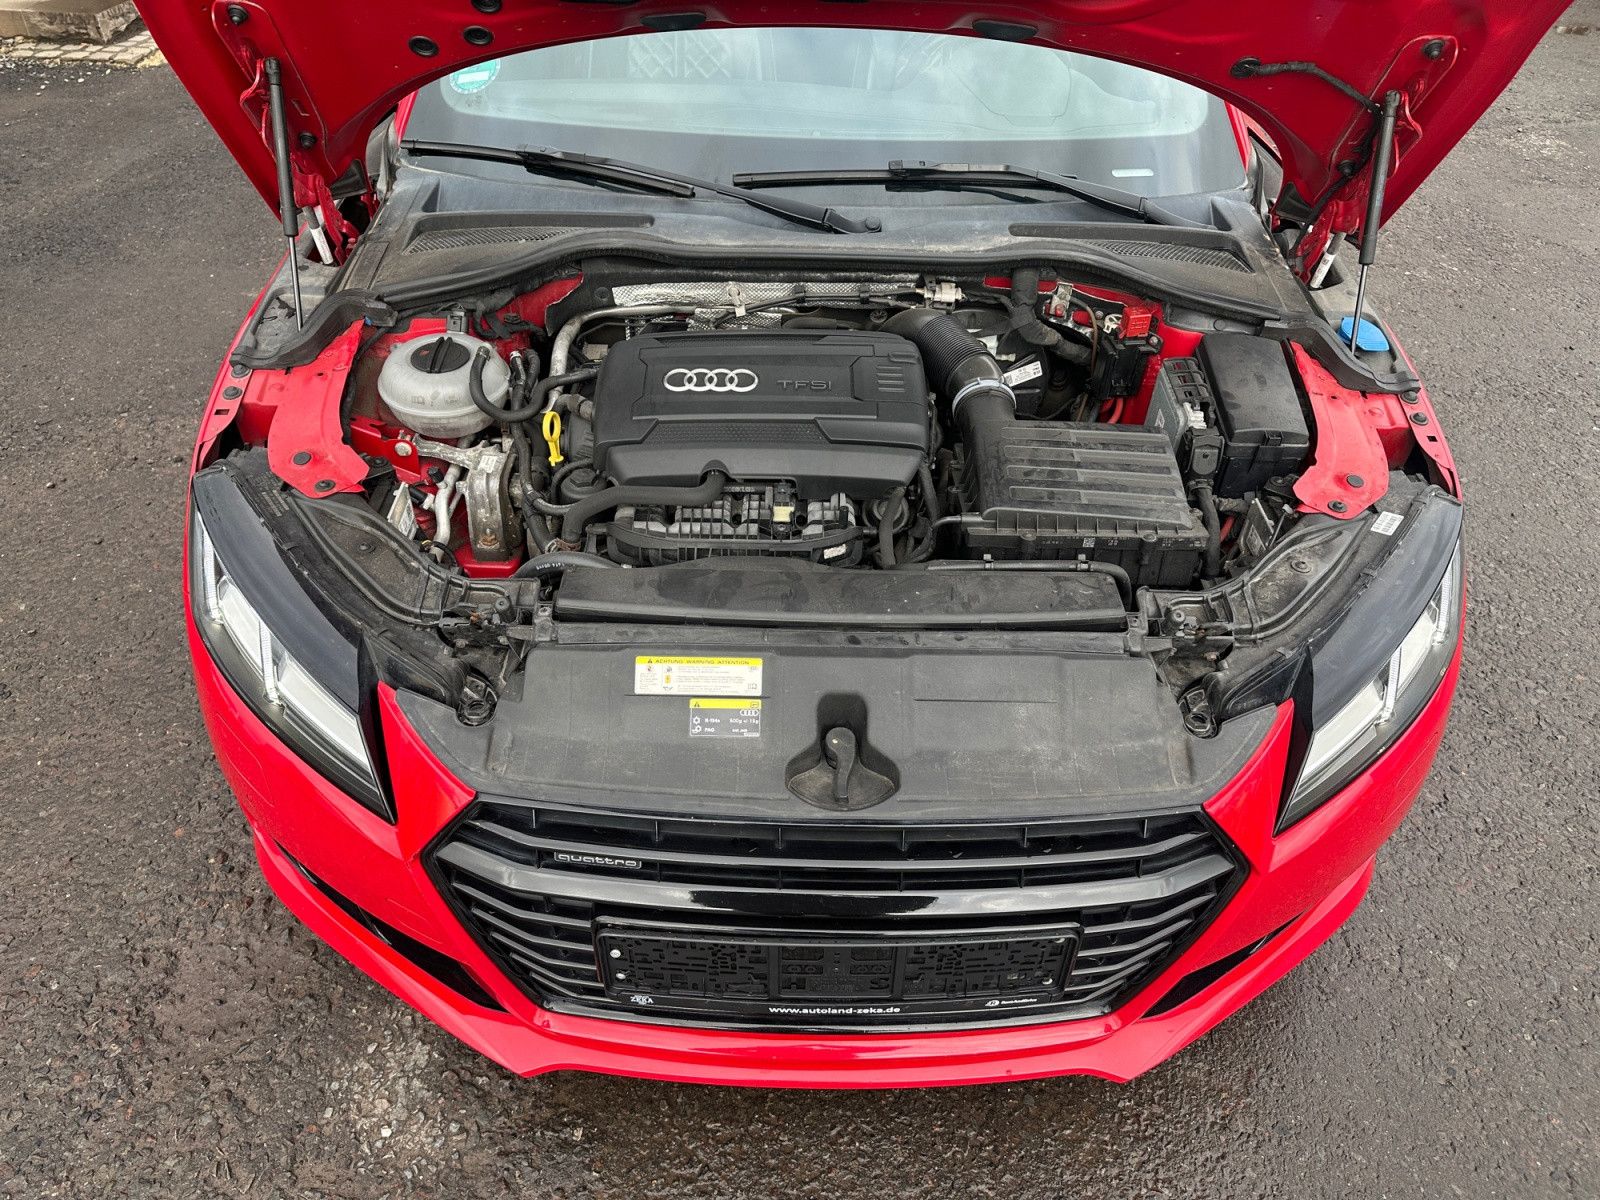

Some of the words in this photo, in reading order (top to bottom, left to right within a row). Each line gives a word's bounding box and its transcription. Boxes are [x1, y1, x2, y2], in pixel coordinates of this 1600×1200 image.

[777, 380, 831, 389] TFSI
[558, 854, 637, 867] quattro
[768, 1006, 901, 1015] www.autoland-zeka.de
